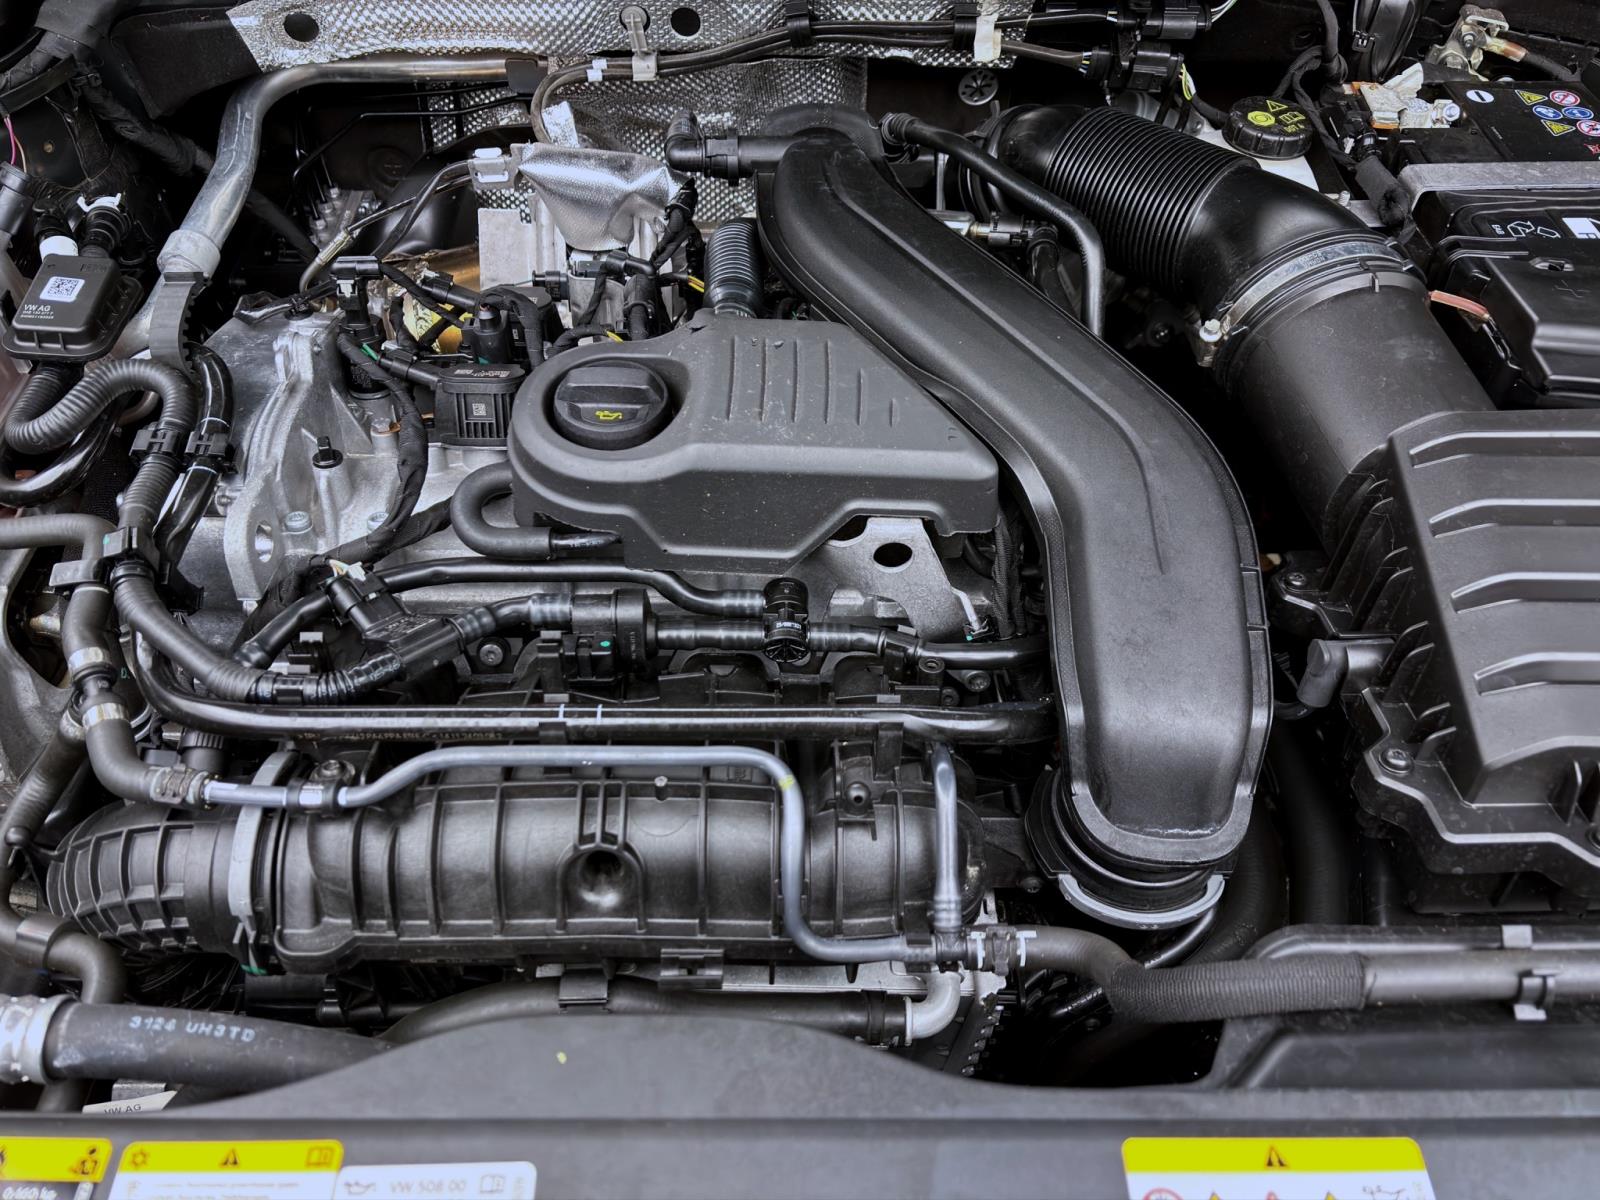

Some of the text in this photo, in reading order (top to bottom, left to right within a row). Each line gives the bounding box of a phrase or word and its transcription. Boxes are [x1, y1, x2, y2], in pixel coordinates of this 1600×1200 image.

[37, 304, 51, 312] AG
[125, 1103, 142, 1113] AG
[389, 1180, 415, 1194] VW
